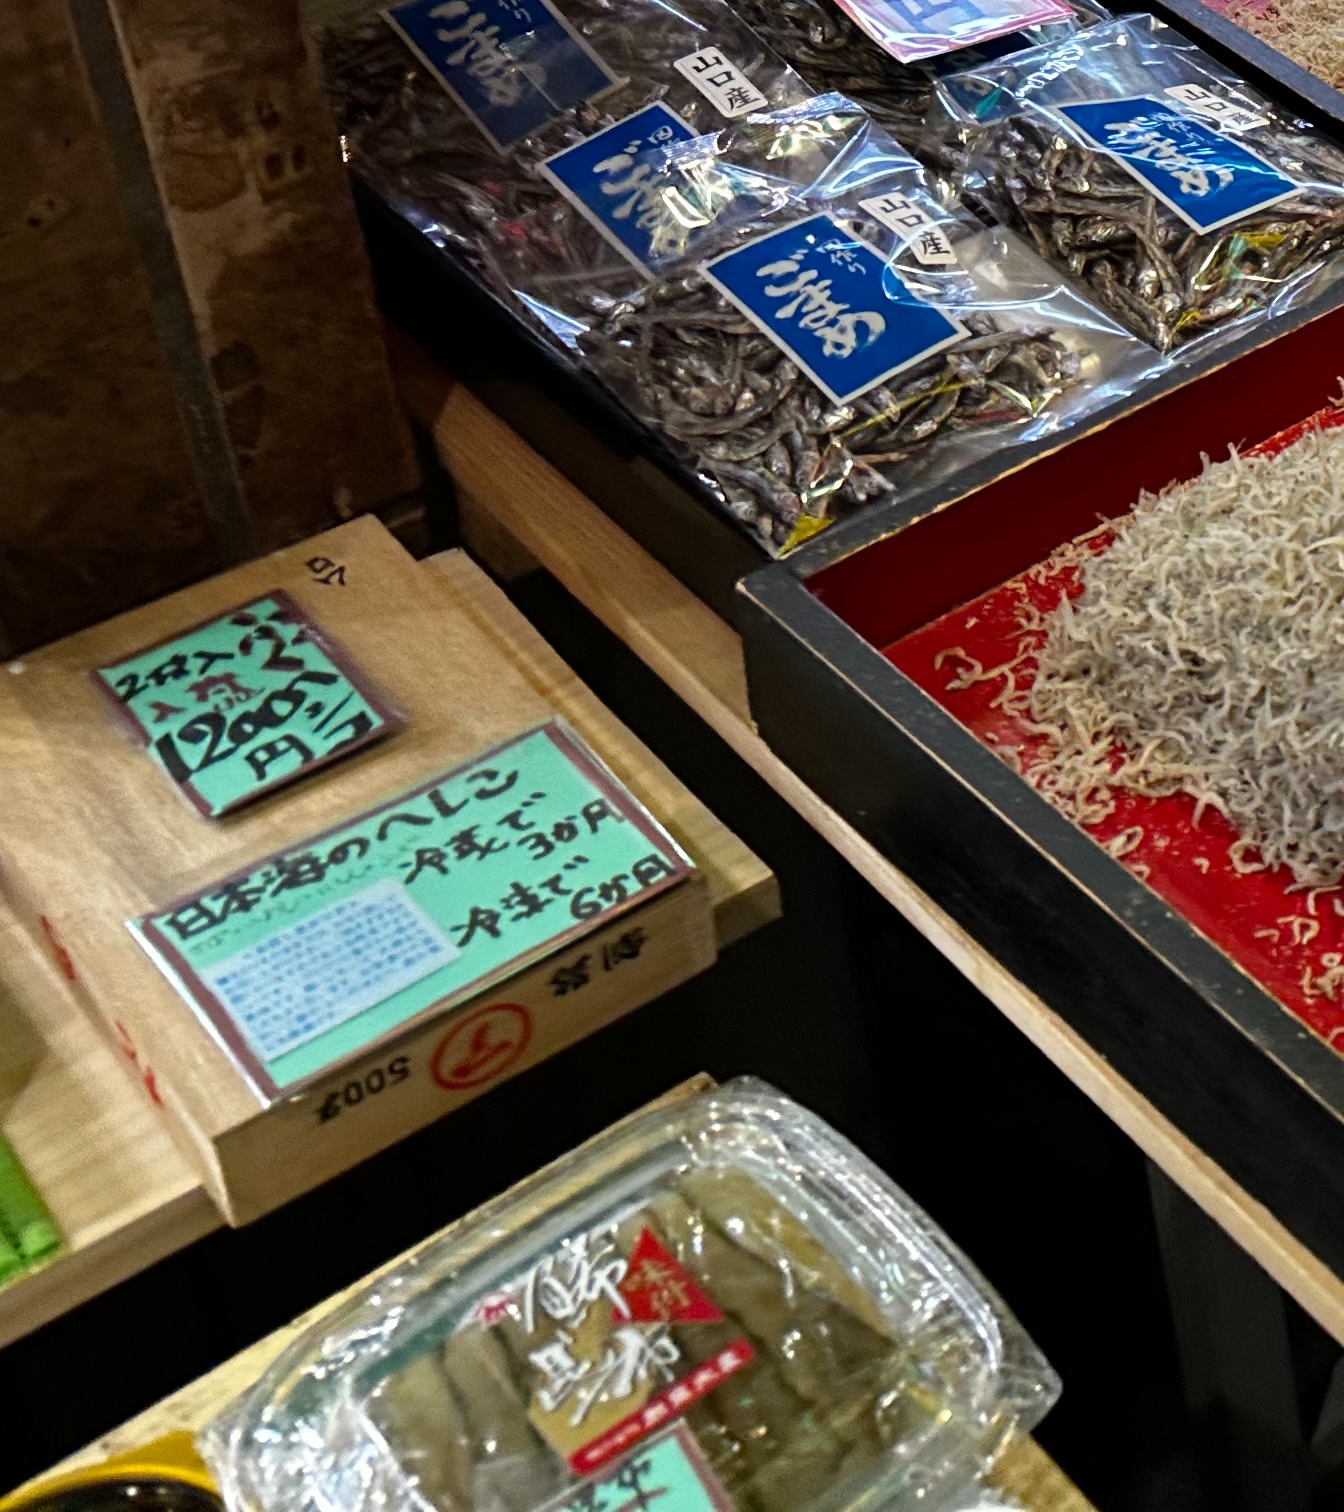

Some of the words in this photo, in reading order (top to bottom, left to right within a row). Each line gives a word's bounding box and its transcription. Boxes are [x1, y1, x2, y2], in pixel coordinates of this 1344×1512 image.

[693, 54, 759, 114] 山口産
[875, 198, 951, 258] 山口産
[169, 767, 519, 942] 日本海のへしこ
